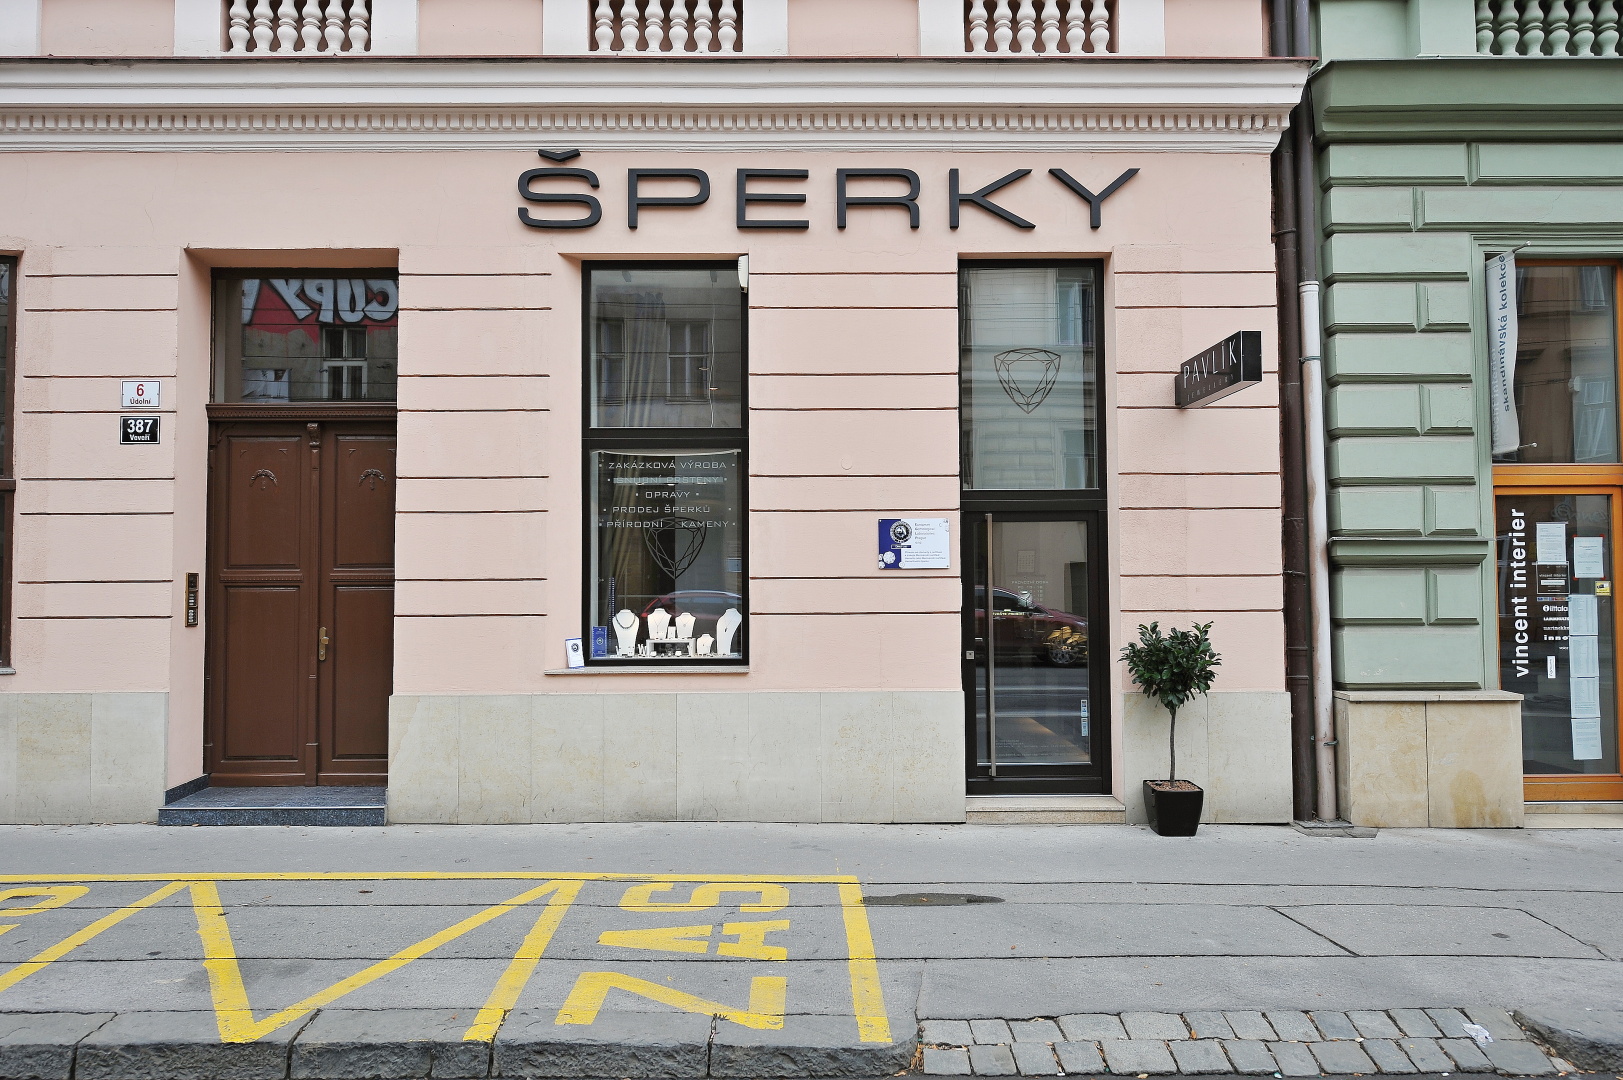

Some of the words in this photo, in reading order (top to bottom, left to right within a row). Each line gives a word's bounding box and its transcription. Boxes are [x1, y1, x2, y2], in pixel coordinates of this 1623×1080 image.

[517, 149, 1140, 231] ŠPERKY
[1498, 254, 1507, 309] kolekce
[1183, 339, 1237, 389] PAVLÍK
[1498, 313, 1510, 412] skandinávská
[136, 383, 145, 397] 6
[130, 397, 151, 405] Údolní
[127, 419, 153, 433] 387
[129, 433, 151, 441] Veveří
[608, 460, 676, 469] ZAKÁZKOVÁ
[680, 460, 727, 469] VÝROBA
[666, 476, 719, 484] PRSTENY
[645, 491, 690, 499] OPRAVY
[664, 504, 710, 513] ŠPERKŮ
[606, 519, 663, 528] PŘÍRODNÍ
[681, 520, 729, 528] KAMENY
[1508, 509, 1527, 588] interier
[1511, 596, 1529, 677] vincent
